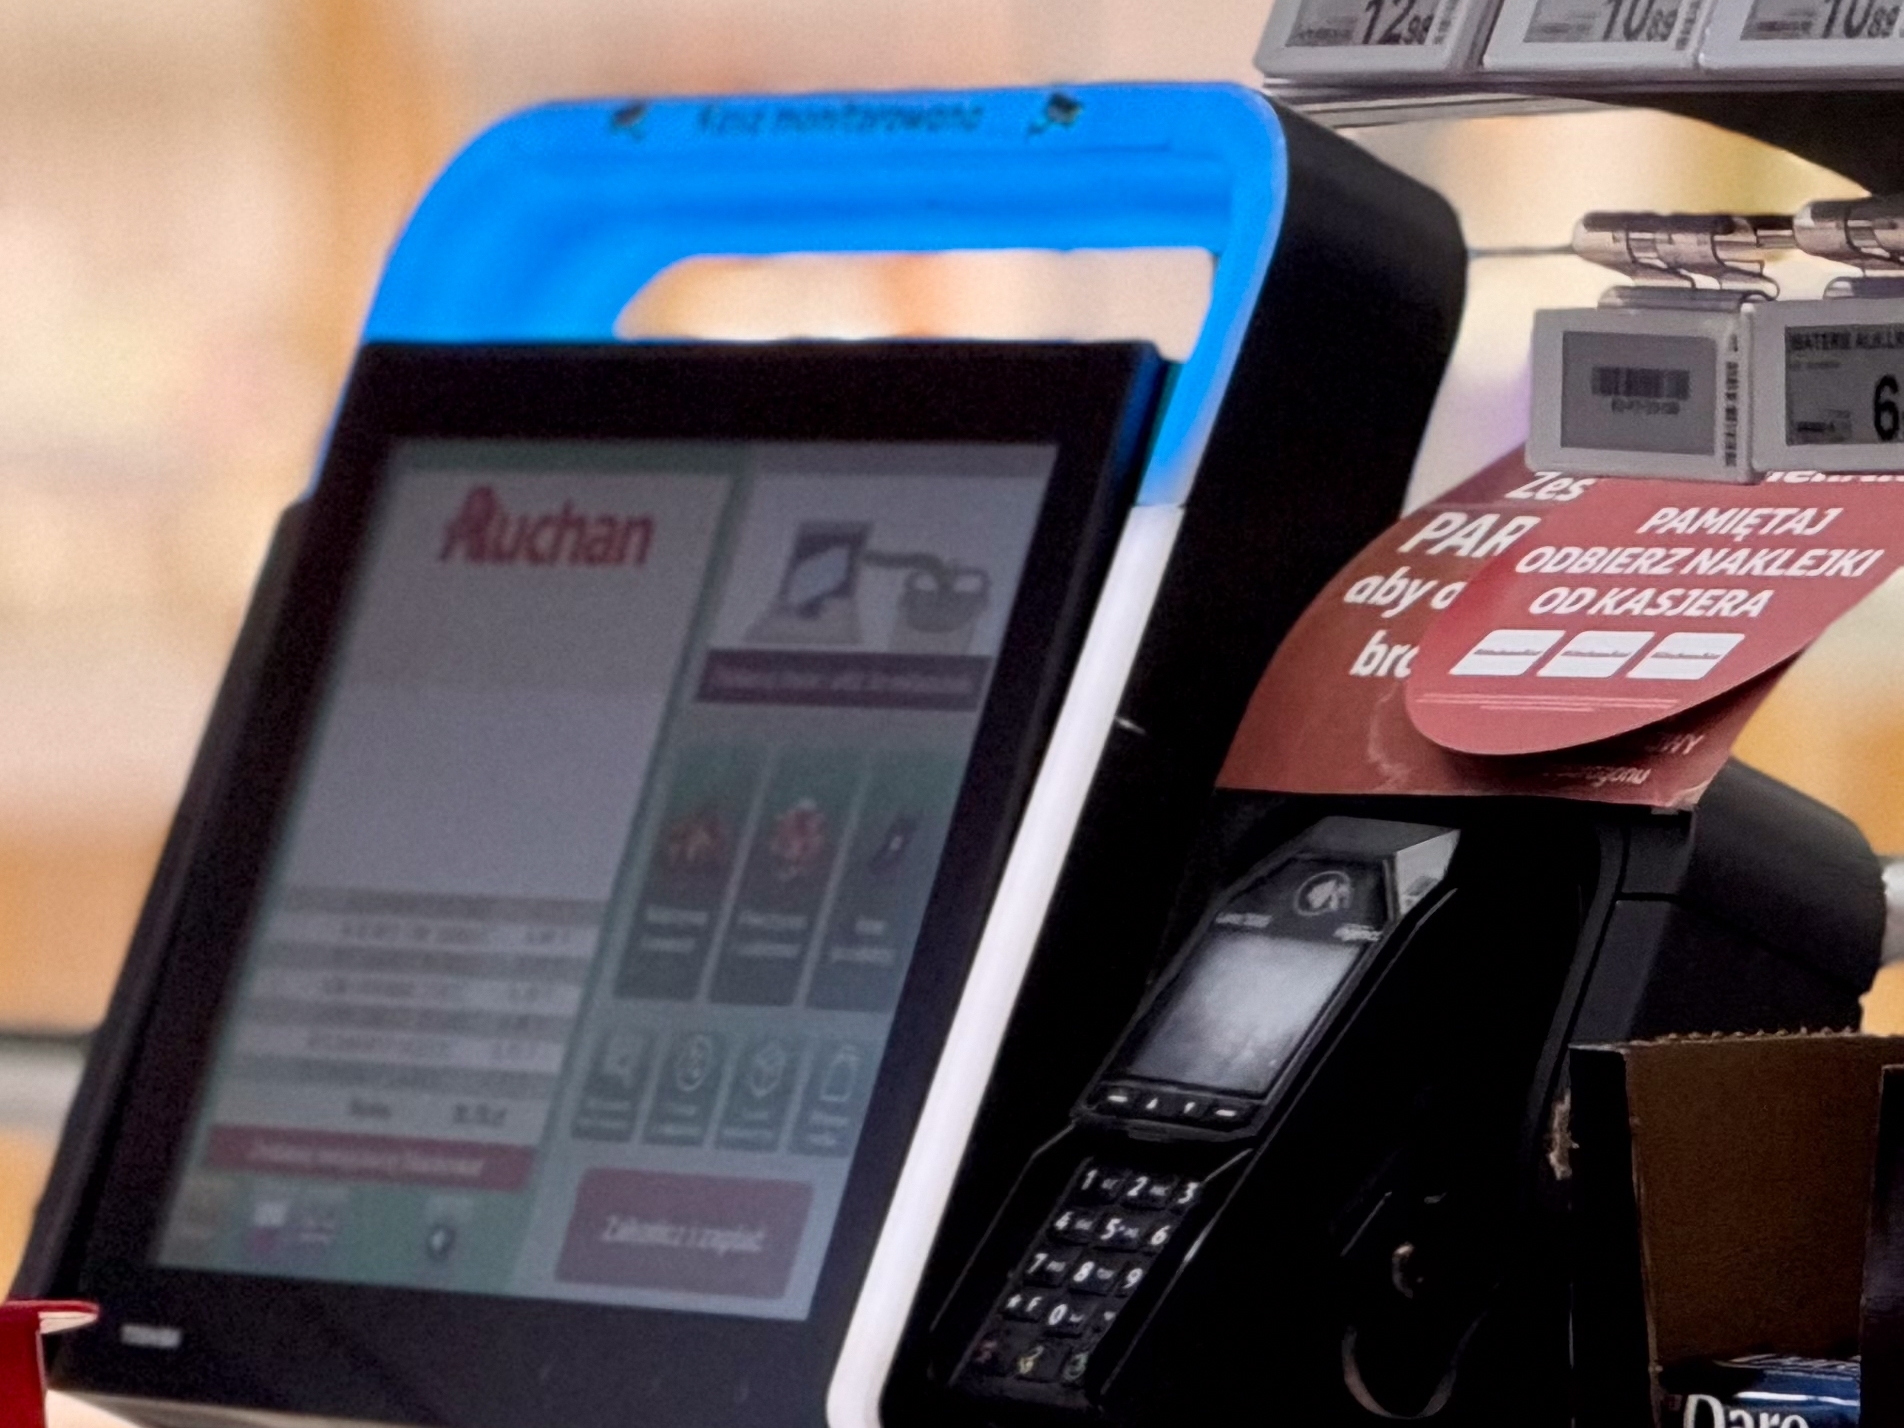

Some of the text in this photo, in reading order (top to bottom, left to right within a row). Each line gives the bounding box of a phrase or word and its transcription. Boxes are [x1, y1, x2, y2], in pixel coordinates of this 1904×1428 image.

[438, 484, 654, 567] Auchan
[1637, 507, 1845, 542] PAMIĘTAJ
[1514, 546, 1886, 578] ODBIERZ NAKLEJKI
[1343, 566, 1438, 618] aby
[1528, 587, 1774, 618] OD KASJERA
